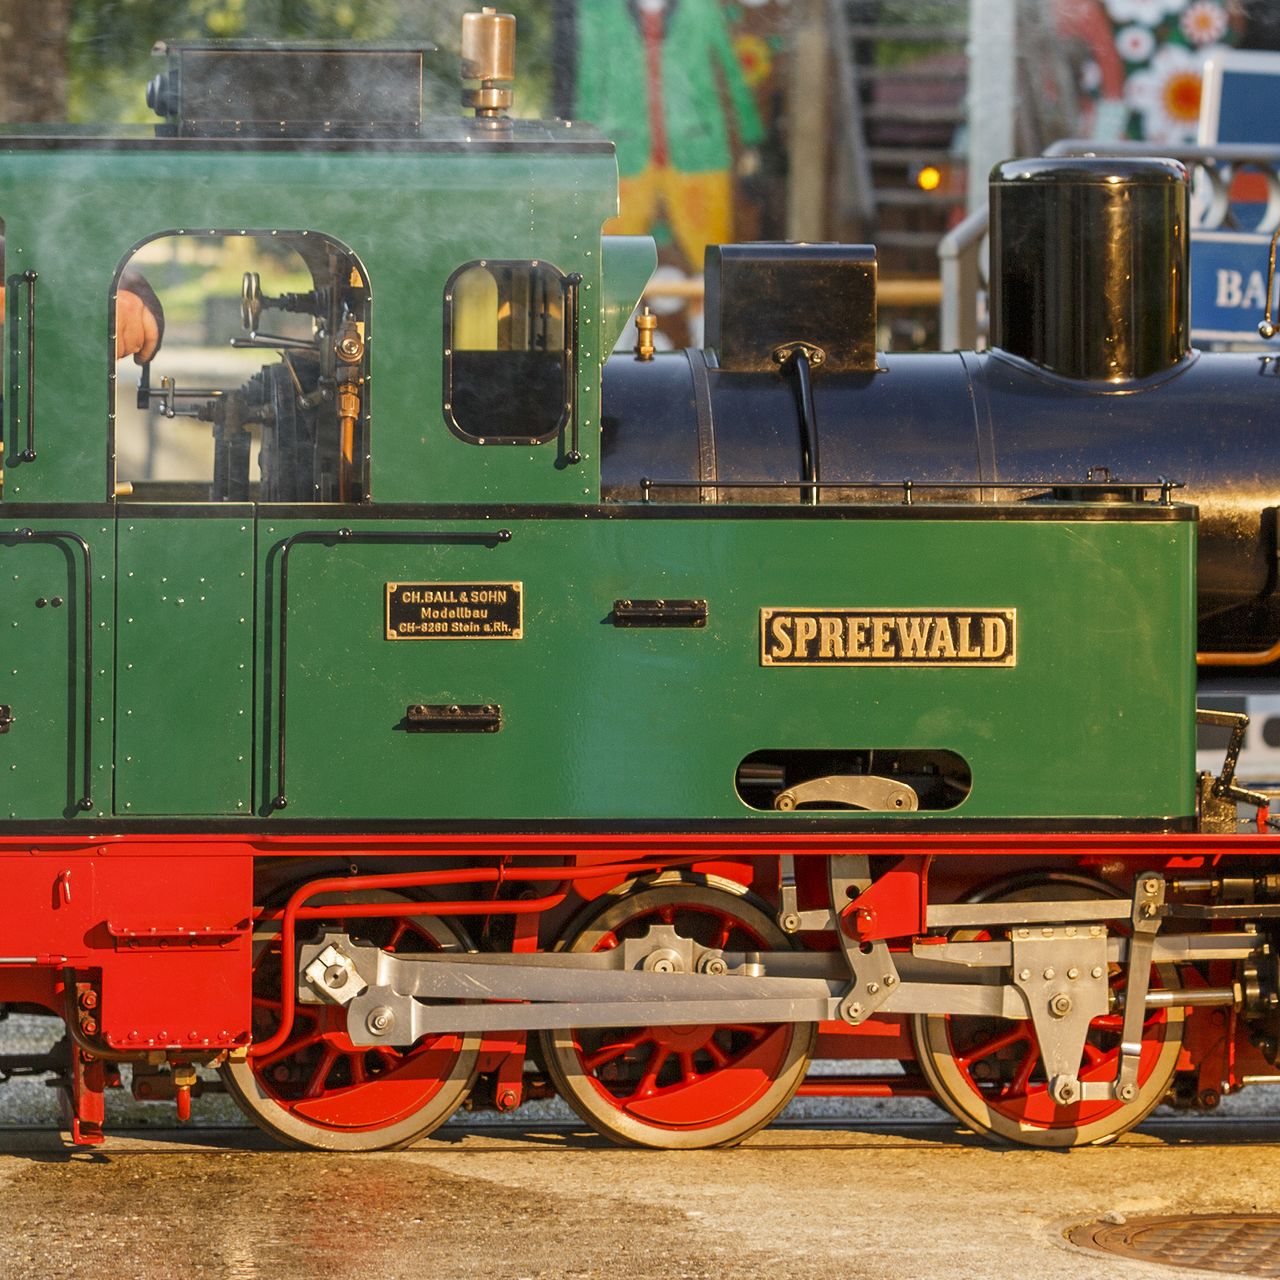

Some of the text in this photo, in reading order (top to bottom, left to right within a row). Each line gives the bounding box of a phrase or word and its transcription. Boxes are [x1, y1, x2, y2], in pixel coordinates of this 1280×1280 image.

[402, 590, 508, 604] CH.BALL & SOHN
[421, 607, 488, 620] Modellbau
[451, 622, 480, 633] Stein
[772, 617, 1007, 658] SPREEWALD
